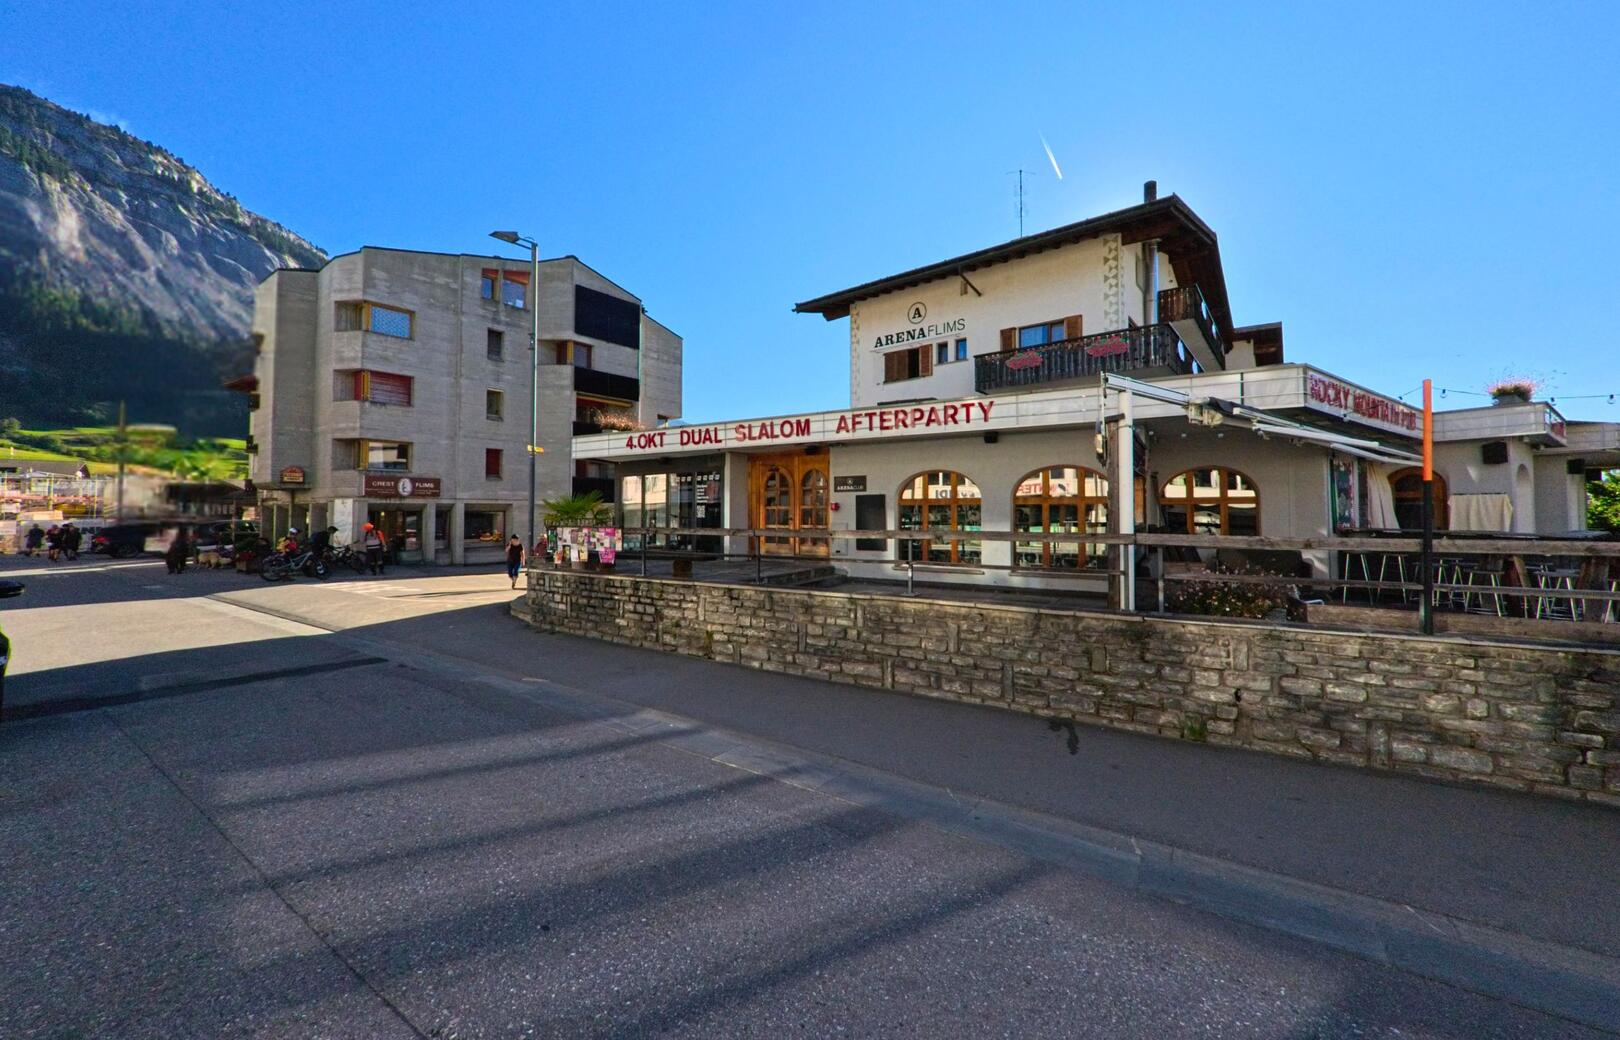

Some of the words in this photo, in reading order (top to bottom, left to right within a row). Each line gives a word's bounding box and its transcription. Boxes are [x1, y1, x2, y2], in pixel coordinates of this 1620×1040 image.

[912, 307, 922, 319] A
[874, 318, 966, 348] ARENAFLIMS
[626, 432, 666, 450] 4.OKT
[680, 427, 723, 446] DUAL
[735, 418, 811, 442] SLALOM
[836, 401, 994, 433] AFTERPARTY
